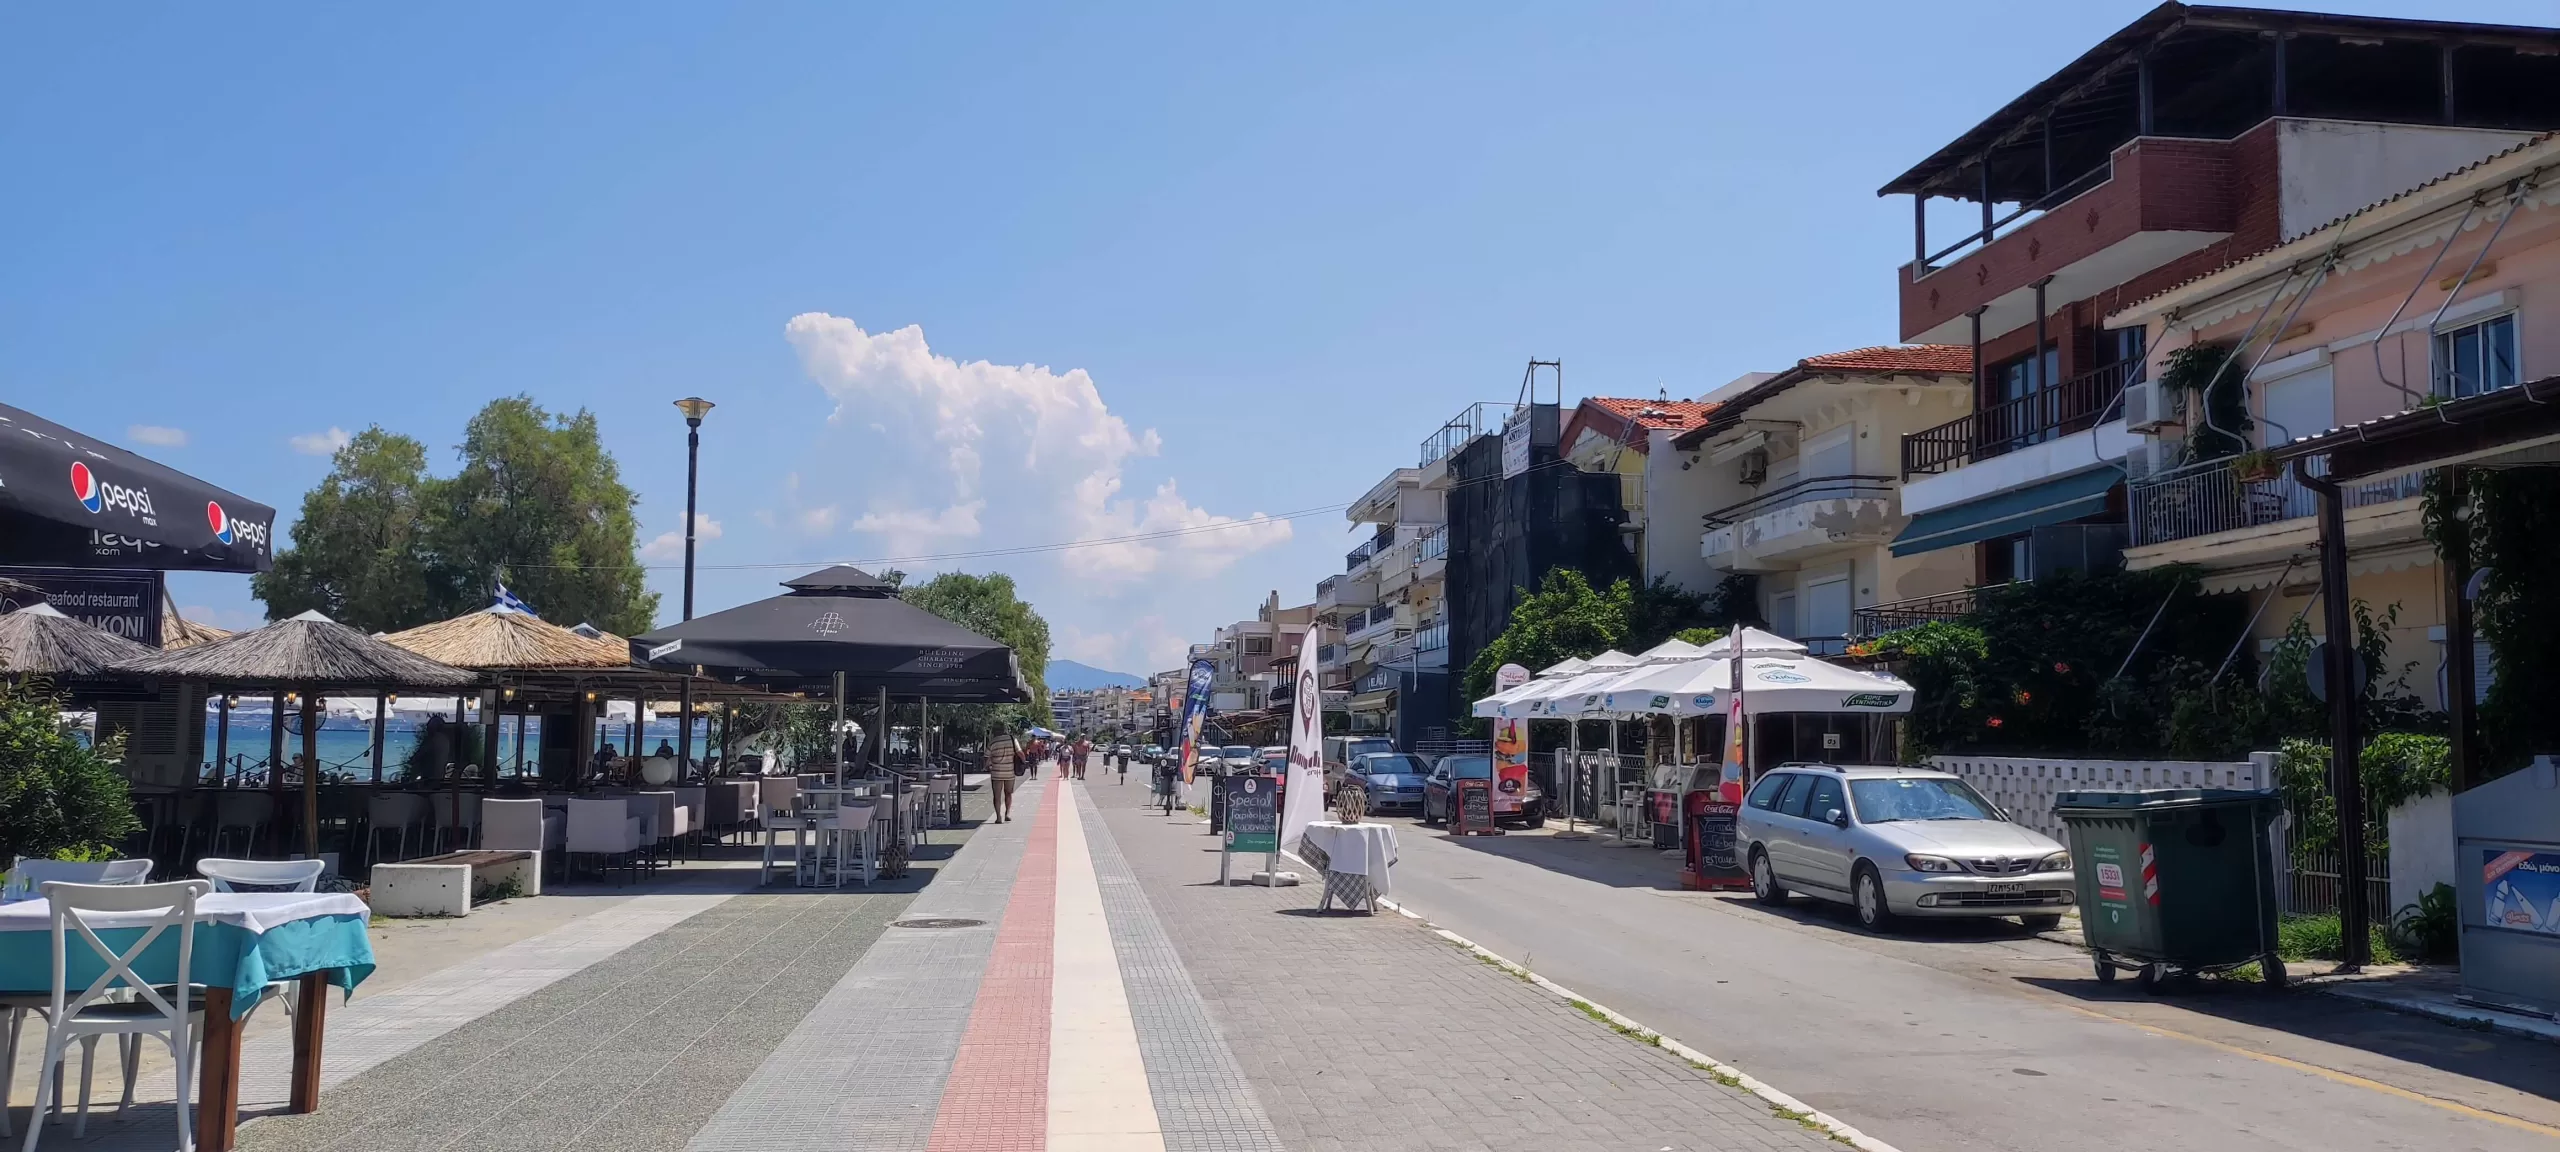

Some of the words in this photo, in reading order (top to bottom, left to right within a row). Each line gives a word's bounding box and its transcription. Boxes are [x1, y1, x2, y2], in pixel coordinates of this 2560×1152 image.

[101, 481, 155, 516] pepsi
[142, 515, 158, 527] max
[231, 517, 267, 549] pepsi
[46, 590, 86, 606] seafood
[88, 591, 139, 608] restaurant
[919, 649, 964, 657] BUILDING
[1229, 791, 1272, 808] Special
[2539, 862, 2560, 873] μόνο
